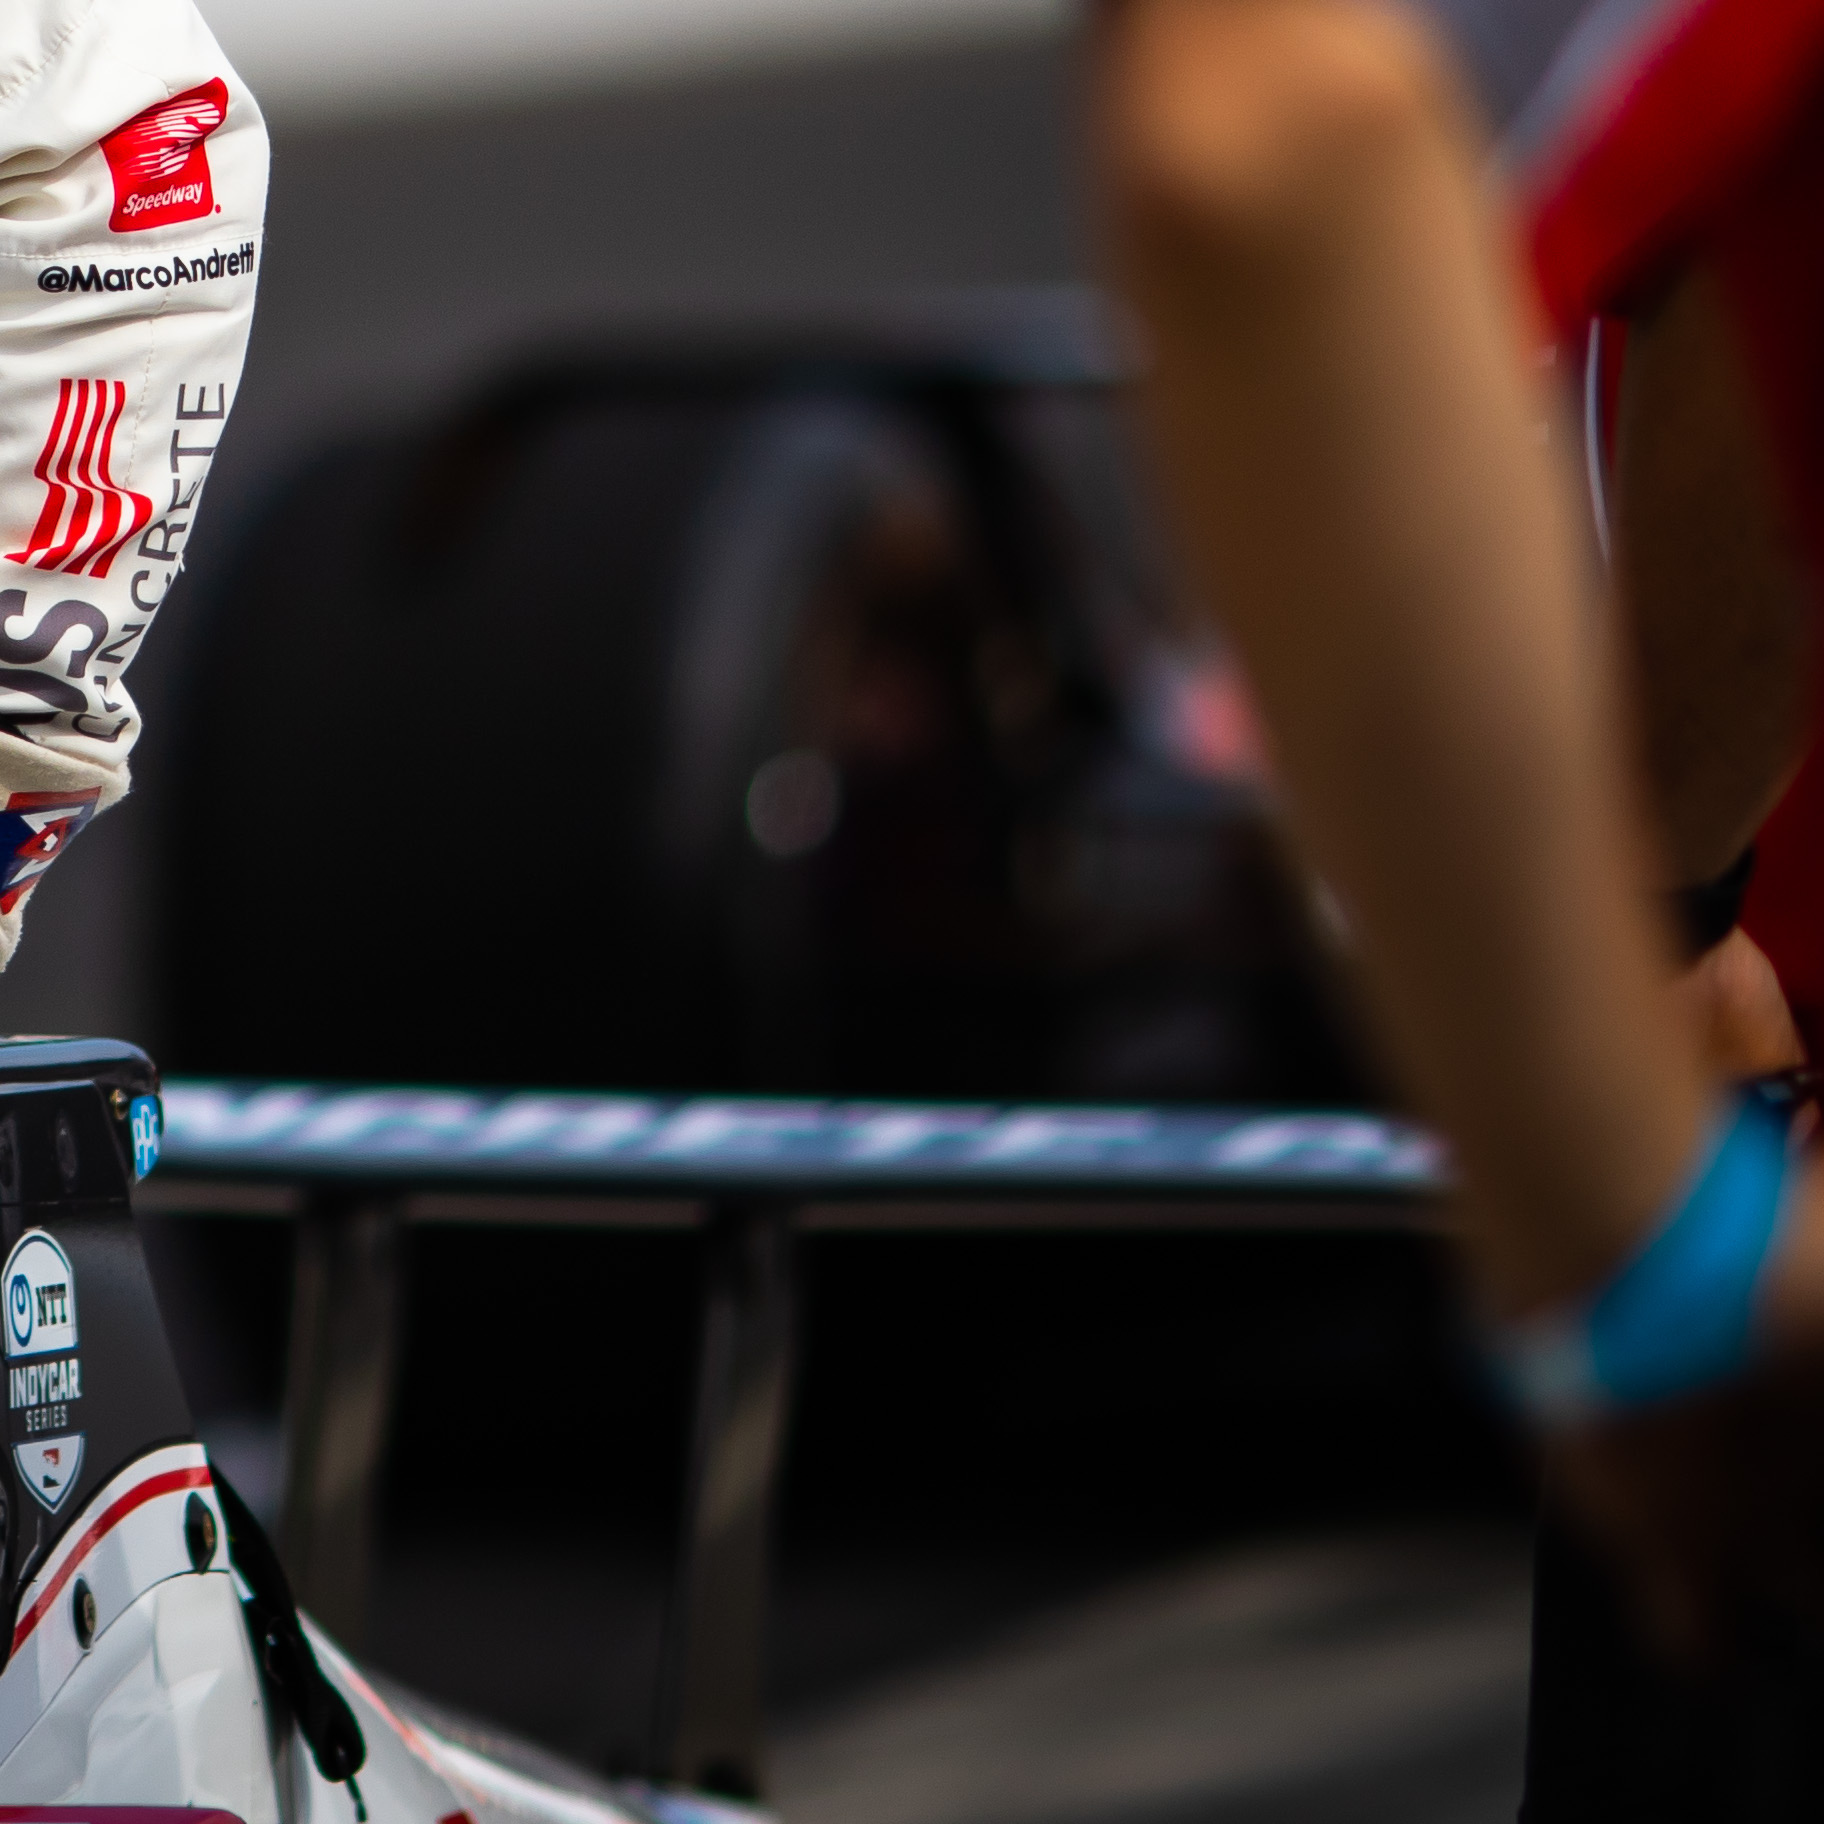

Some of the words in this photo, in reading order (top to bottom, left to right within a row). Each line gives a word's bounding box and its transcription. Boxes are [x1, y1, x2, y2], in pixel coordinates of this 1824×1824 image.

[122, 181, 204, 218] Speedway
[37, 240, 255, 294] @MarcoAndretti
[35, 1282, 68, 1327] NTT
[9, 1357, 83, 1410] INDYCAR
[25, 1403, 69, 1433] SERIES
